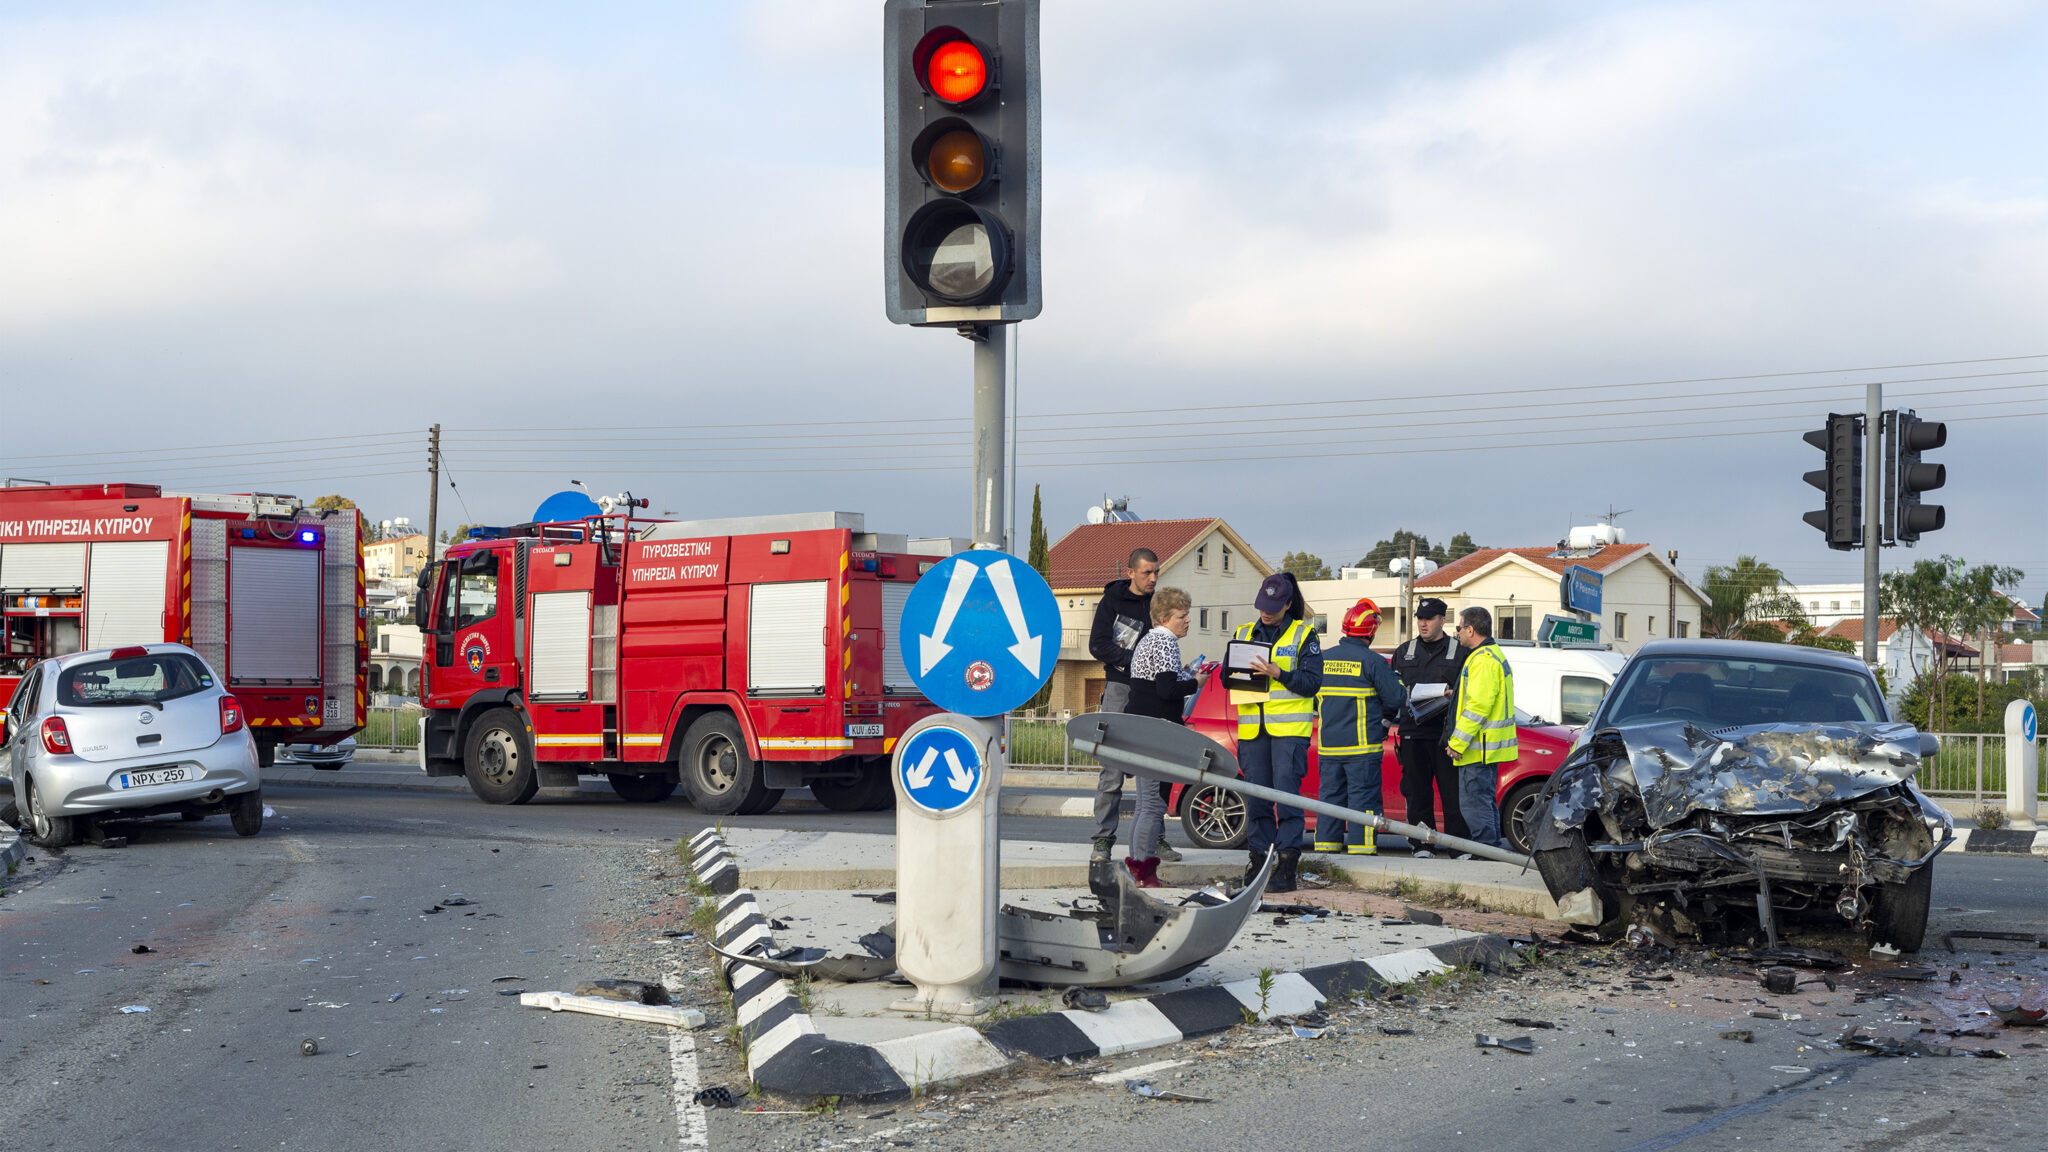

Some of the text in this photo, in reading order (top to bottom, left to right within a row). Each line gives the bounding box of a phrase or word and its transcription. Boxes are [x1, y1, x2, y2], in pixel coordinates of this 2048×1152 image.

[0, 517, 153, 537] ΙΚΗ ΥΠΗΡΕΣΙΑ ΚΥΠΡΟΥ
[642, 542, 711, 558] ΠΥΡΟΣΒΕΣΤΙΚΗ
[632, 564, 719, 582] ΥΠΗΡΕΣΙΑ ΚΥΠΡΟΥ
[325, 701, 338, 709] NEE
[325, 710, 338, 718] 318
[851, 726, 865, 735] KUV
[867, 725, 880, 735] 653
[132, 773, 156, 785] NPX
[163, 769, 185, 782] 259
